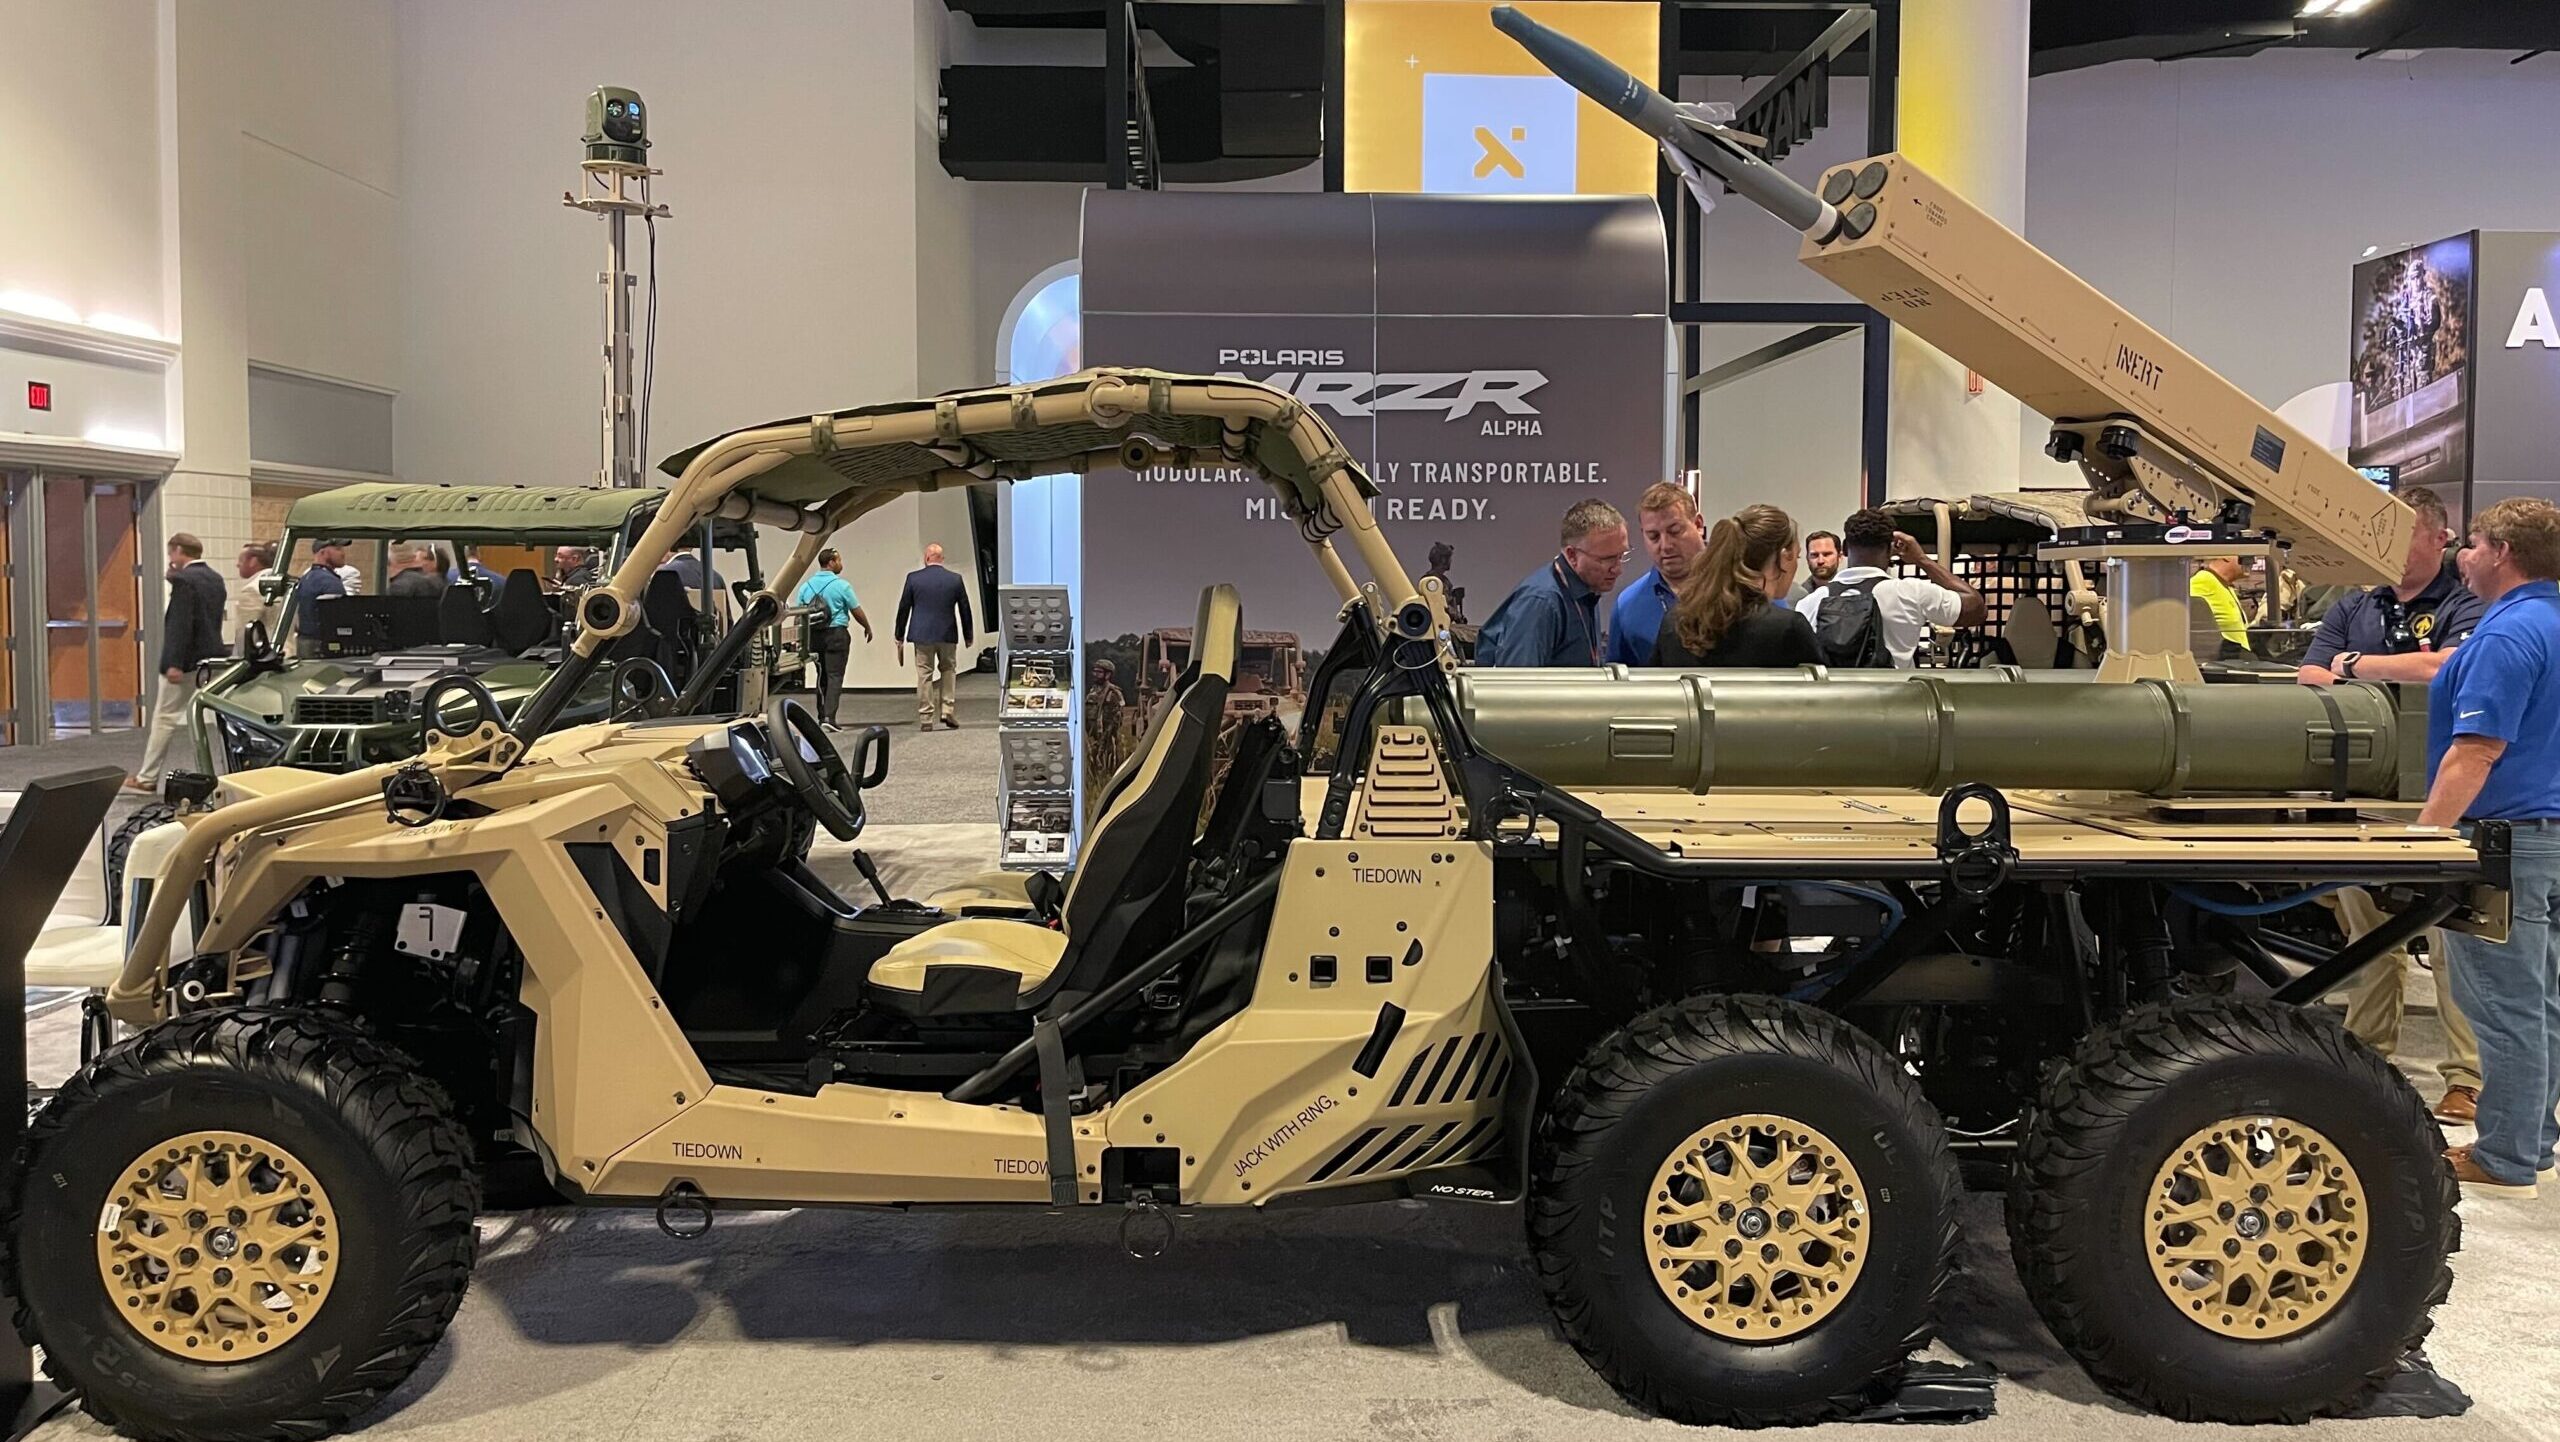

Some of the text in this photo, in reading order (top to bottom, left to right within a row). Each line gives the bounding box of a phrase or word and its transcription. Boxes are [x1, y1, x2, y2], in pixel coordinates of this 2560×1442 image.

[1219, 349, 1344, 366] POLARIS
[2116, 344, 2163, 391] INERT
[1481, 421, 1543, 436] ALPHA
[1411, 462, 1608, 483] TRANSPORTABLE.
[1387, 499, 1497, 520] READY.
[1352, 868, 1421, 883] TIEDOWN
[672, 1142, 742, 1160] TIEDOWN
[1234, 1145, 1269, 1177] JACK
[1263, 1120, 1301, 1151] WITH
[994, 1159, 1051, 1175] TIEDOW
[1430, 1185, 1494, 1197] NO STEP
